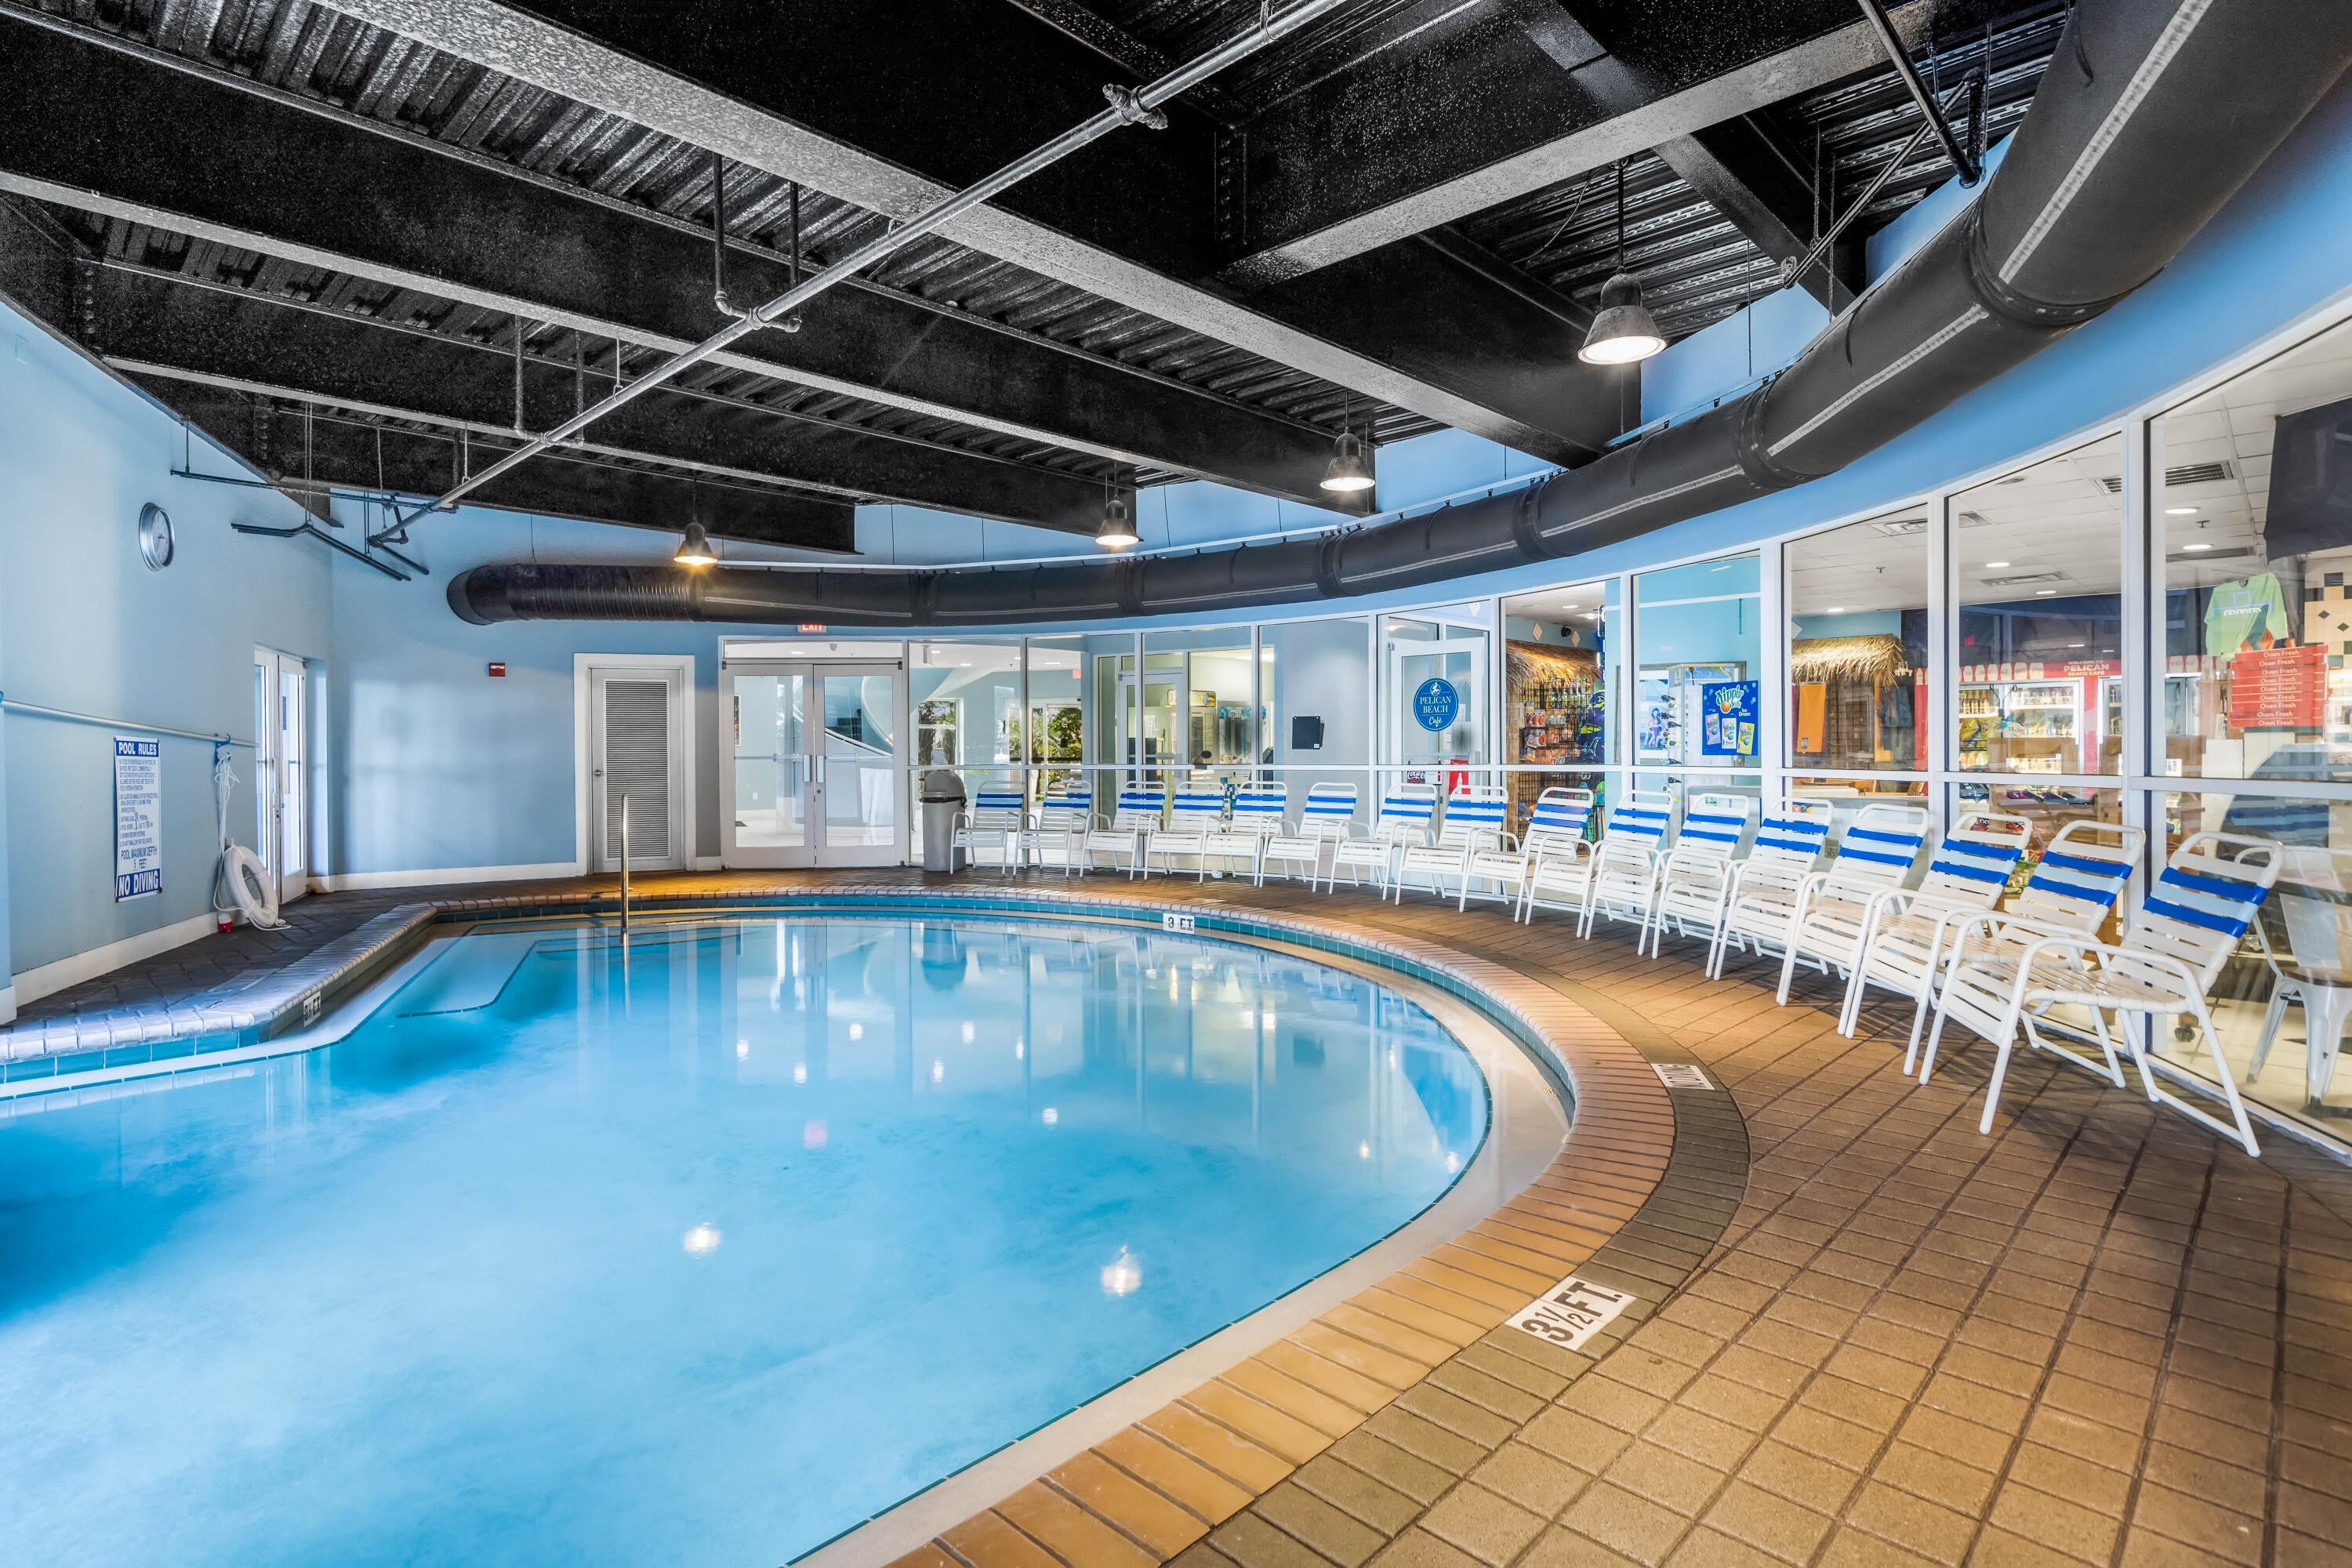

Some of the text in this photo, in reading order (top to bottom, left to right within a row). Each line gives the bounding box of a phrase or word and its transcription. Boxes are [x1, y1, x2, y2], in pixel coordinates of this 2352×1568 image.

[2063, 663, 2110, 673] PELICAN
[1420, 695, 1451, 705] PELICAN
[1423, 705, 1448, 713] BEACH
[118, 742, 157, 756] POOL RULES
[122, 850, 131, 859] POOL
[118, 869, 158, 896] NO DIVING
